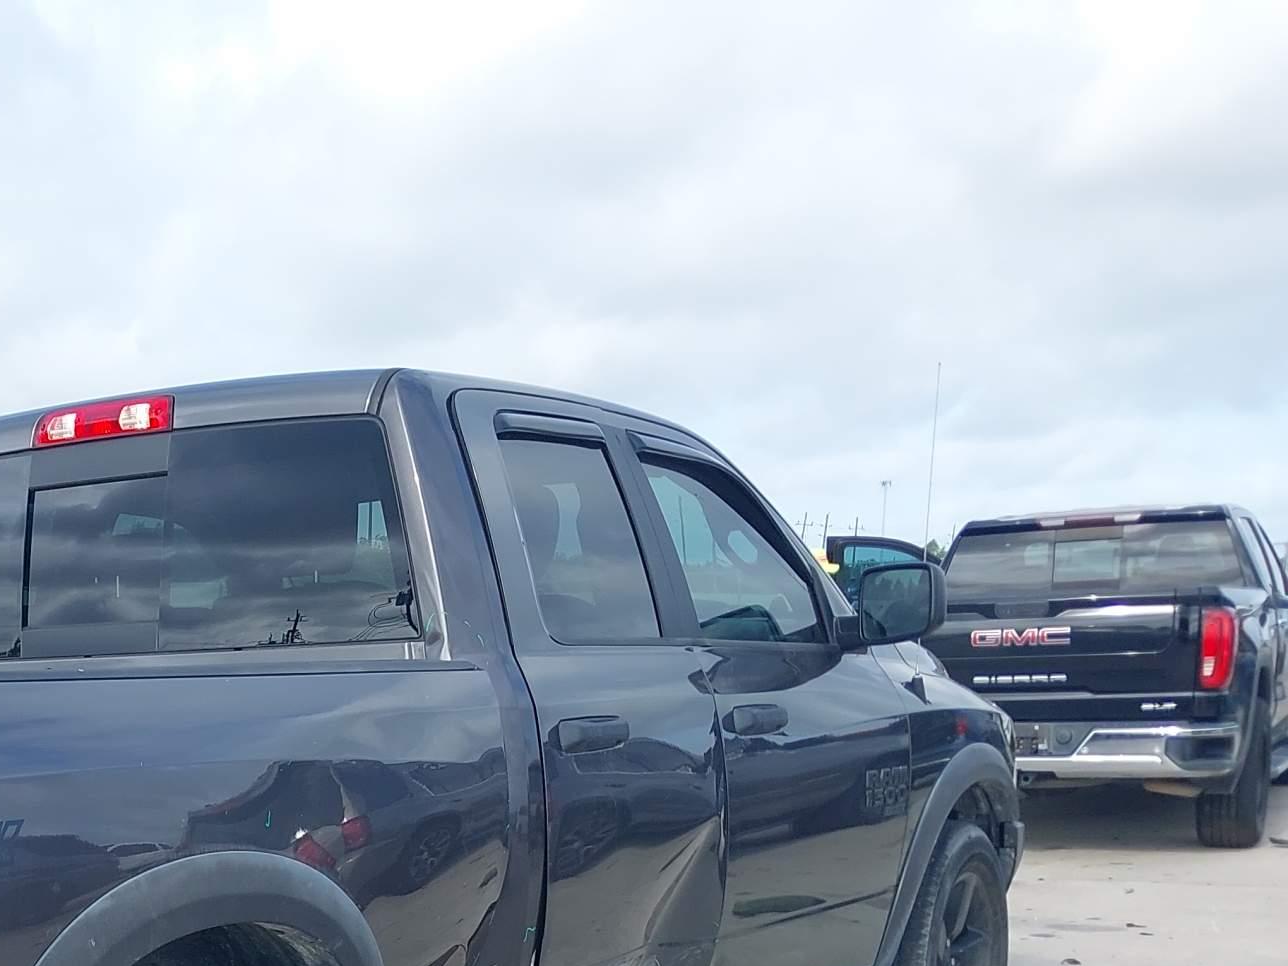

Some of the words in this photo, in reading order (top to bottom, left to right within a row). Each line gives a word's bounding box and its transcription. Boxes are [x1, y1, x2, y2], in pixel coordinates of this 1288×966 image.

[971, 626, 1071, 647] GMC
[865, 765, 908, 788] RAM
[865, 784, 907, 808] 1500
